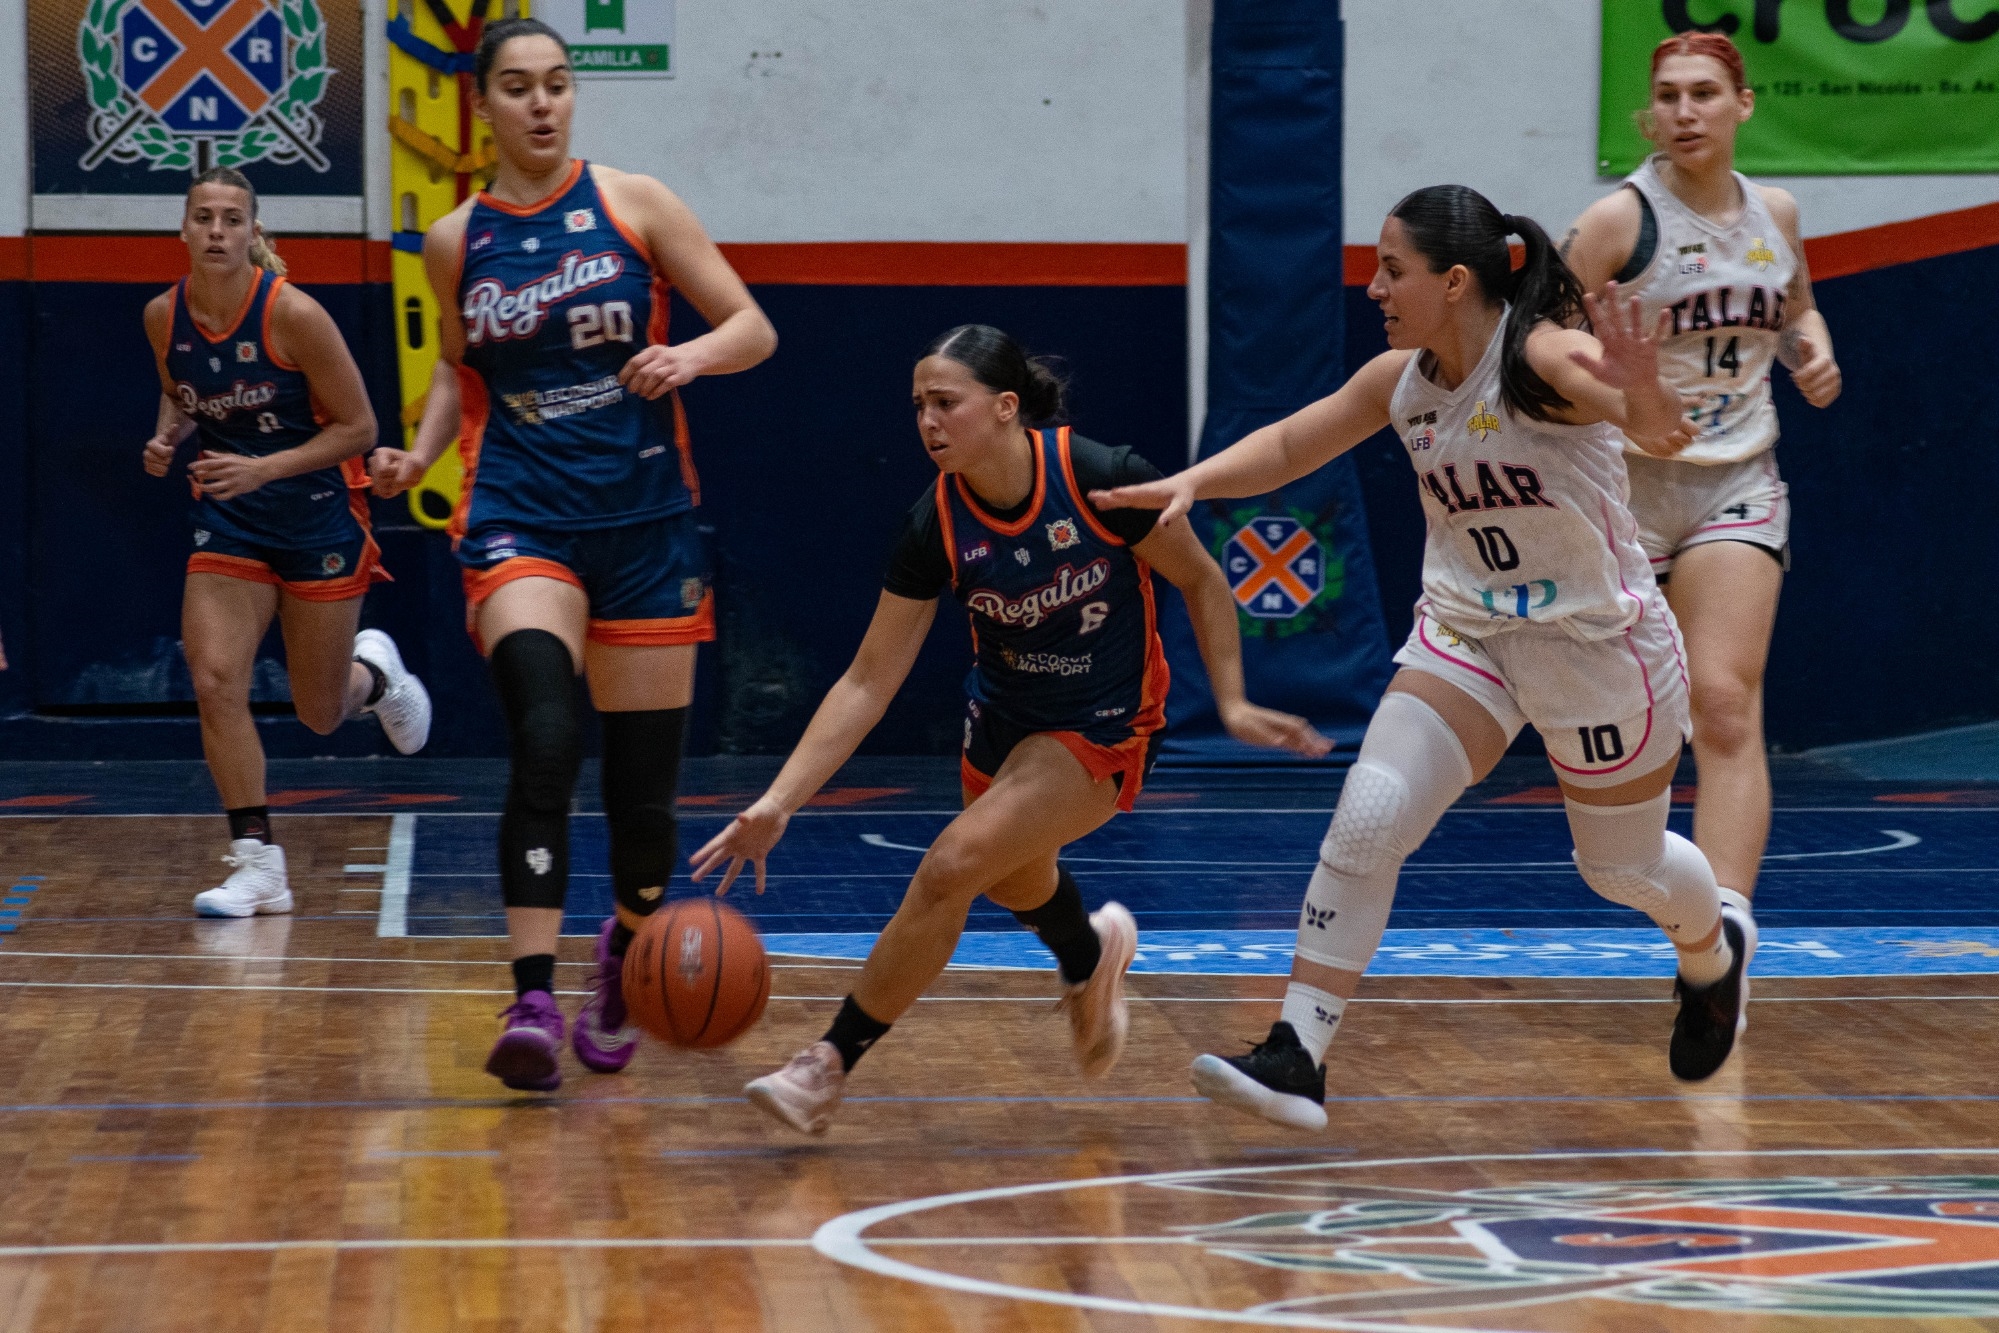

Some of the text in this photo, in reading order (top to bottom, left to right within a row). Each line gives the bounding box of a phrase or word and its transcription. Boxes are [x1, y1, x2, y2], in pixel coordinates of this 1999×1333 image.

[131, 36, 158, 62] C
[247, 38, 273, 63] R
[569, 50, 642, 66] CAMILLA
[189, 96, 218, 121] N
[463, 252, 622, 344] Regatas
[566, 301, 634, 350] 20
[1705, 336, 1739, 377] 14
[177, 383, 276, 420] Regatas
[1407, 410, 1437, 427] YOU ARE
[1411, 437, 1430, 451] LFB
[1267, 524, 1283, 540] S
[964, 546, 987, 561] LFB
[1467, 526, 1520, 571] 10
[1230, 557, 1248, 574] C
[1299, 559, 1317, 576] R
[968, 563, 1108, 628] Regatas
[1262, 593, 1282, 610] N
[1578, 723, 1625, 763] 10
